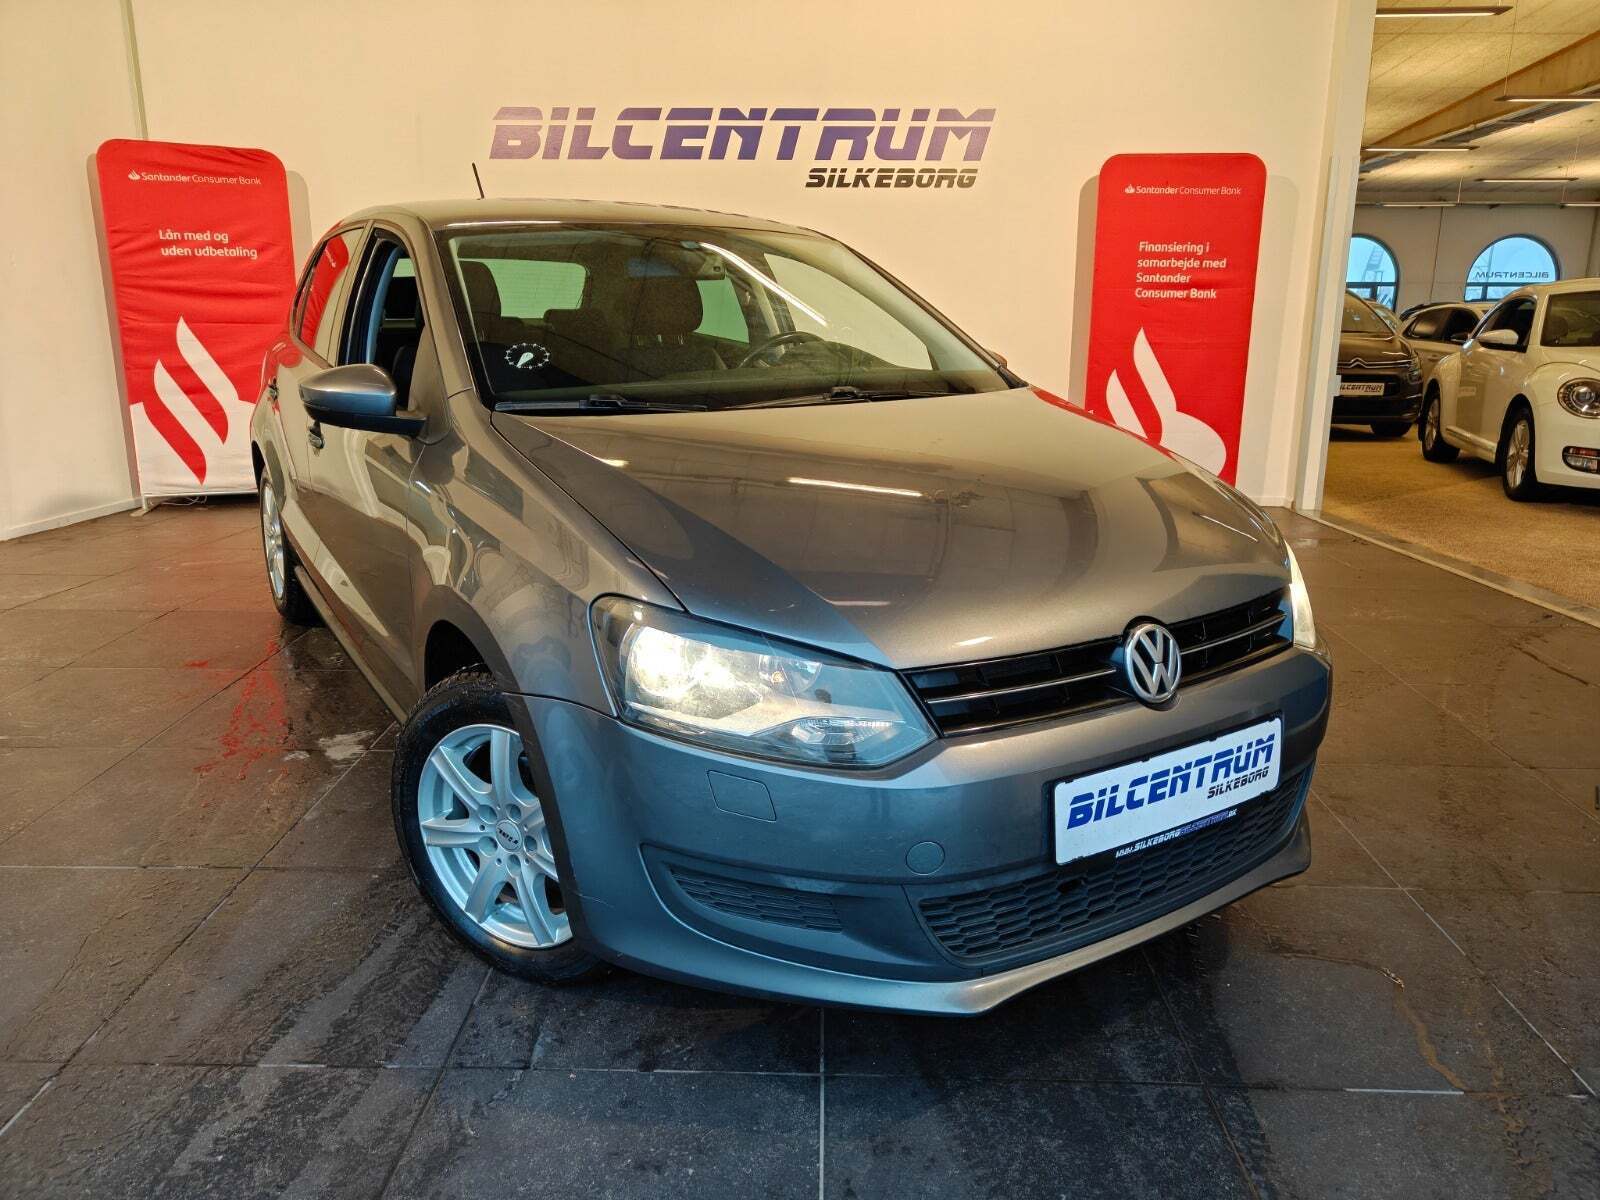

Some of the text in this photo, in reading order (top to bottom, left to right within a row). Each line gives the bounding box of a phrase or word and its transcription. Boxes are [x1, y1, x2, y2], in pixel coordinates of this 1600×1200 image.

[489, 107, 996, 162] BILCENTRUM
[141, 172, 262, 185] Santander Consumer Bank
[805, 168, 979, 189] SILKEBORG
[1135, 185, 1241, 195] Santander Consumer Bank
[159, 229, 229, 243] Lån med og
[161, 246, 258, 260] uden udbetaling
[1139, 241, 1210, 255] Finansiering i
[1137, 257, 1227, 270] samarbejde med
[1136, 272, 1192, 283] Santander
[1135, 287, 1217, 299] Consumer Bank
[1067, 733, 1275, 829] BILCENTRUM
[1207, 766, 1270, 799] SILKEBORG
